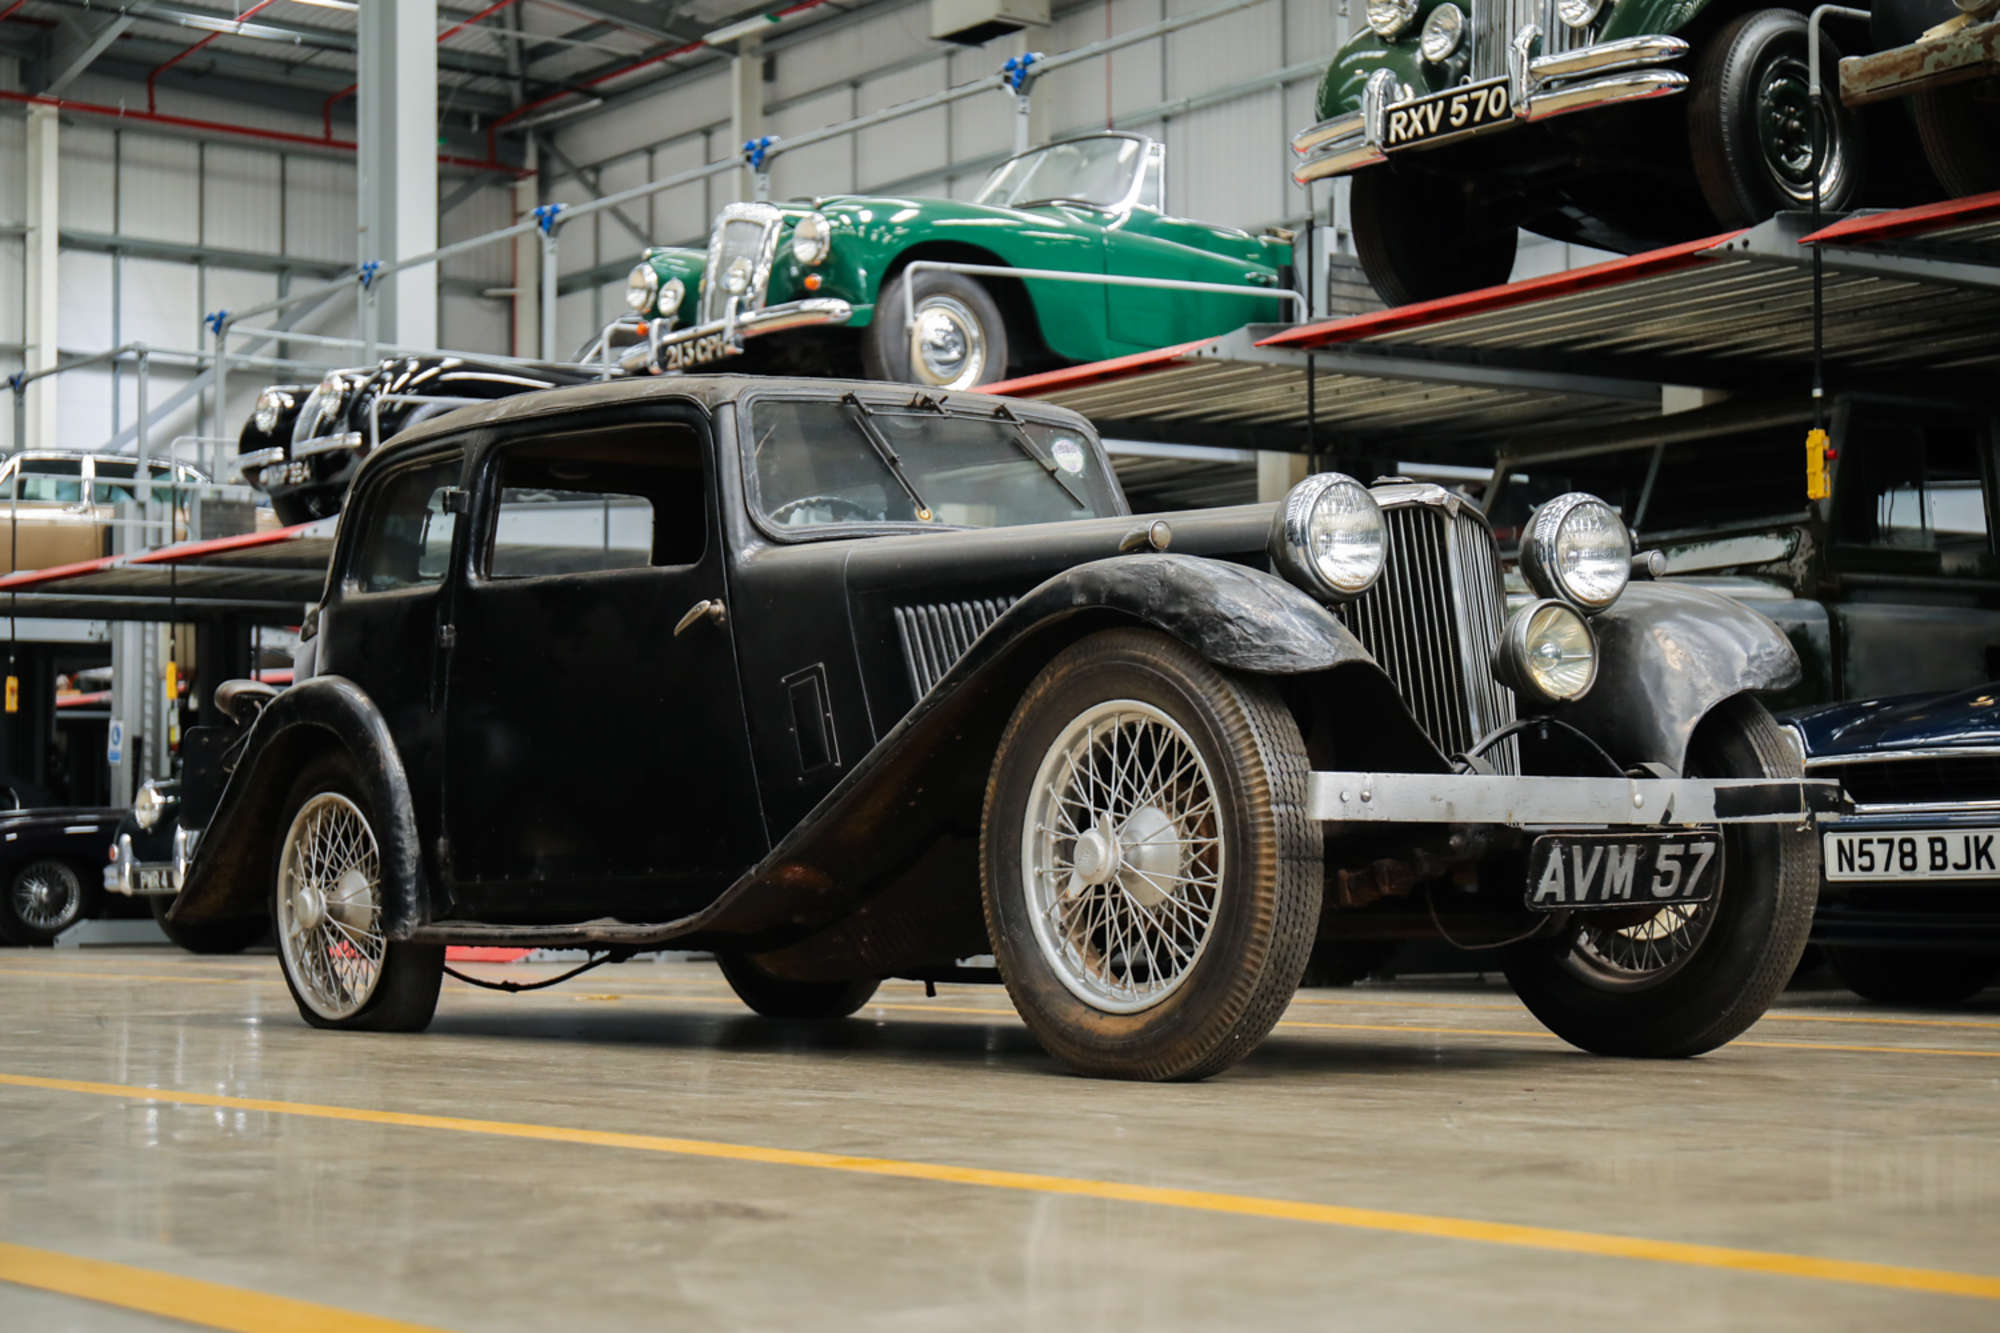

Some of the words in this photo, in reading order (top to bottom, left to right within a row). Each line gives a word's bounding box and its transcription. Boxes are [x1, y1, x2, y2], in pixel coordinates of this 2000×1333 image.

[1390, 101, 1445, 143] RXV
[1449, 86, 1508, 127] 570
[666, 341, 694, 369] 213
[1533, 844, 1639, 902] AVM
[1651, 842, 1716, 898] 57
[1836, 837, 1918, 873] N578
[1927, 834, 1996, 871] BJK
